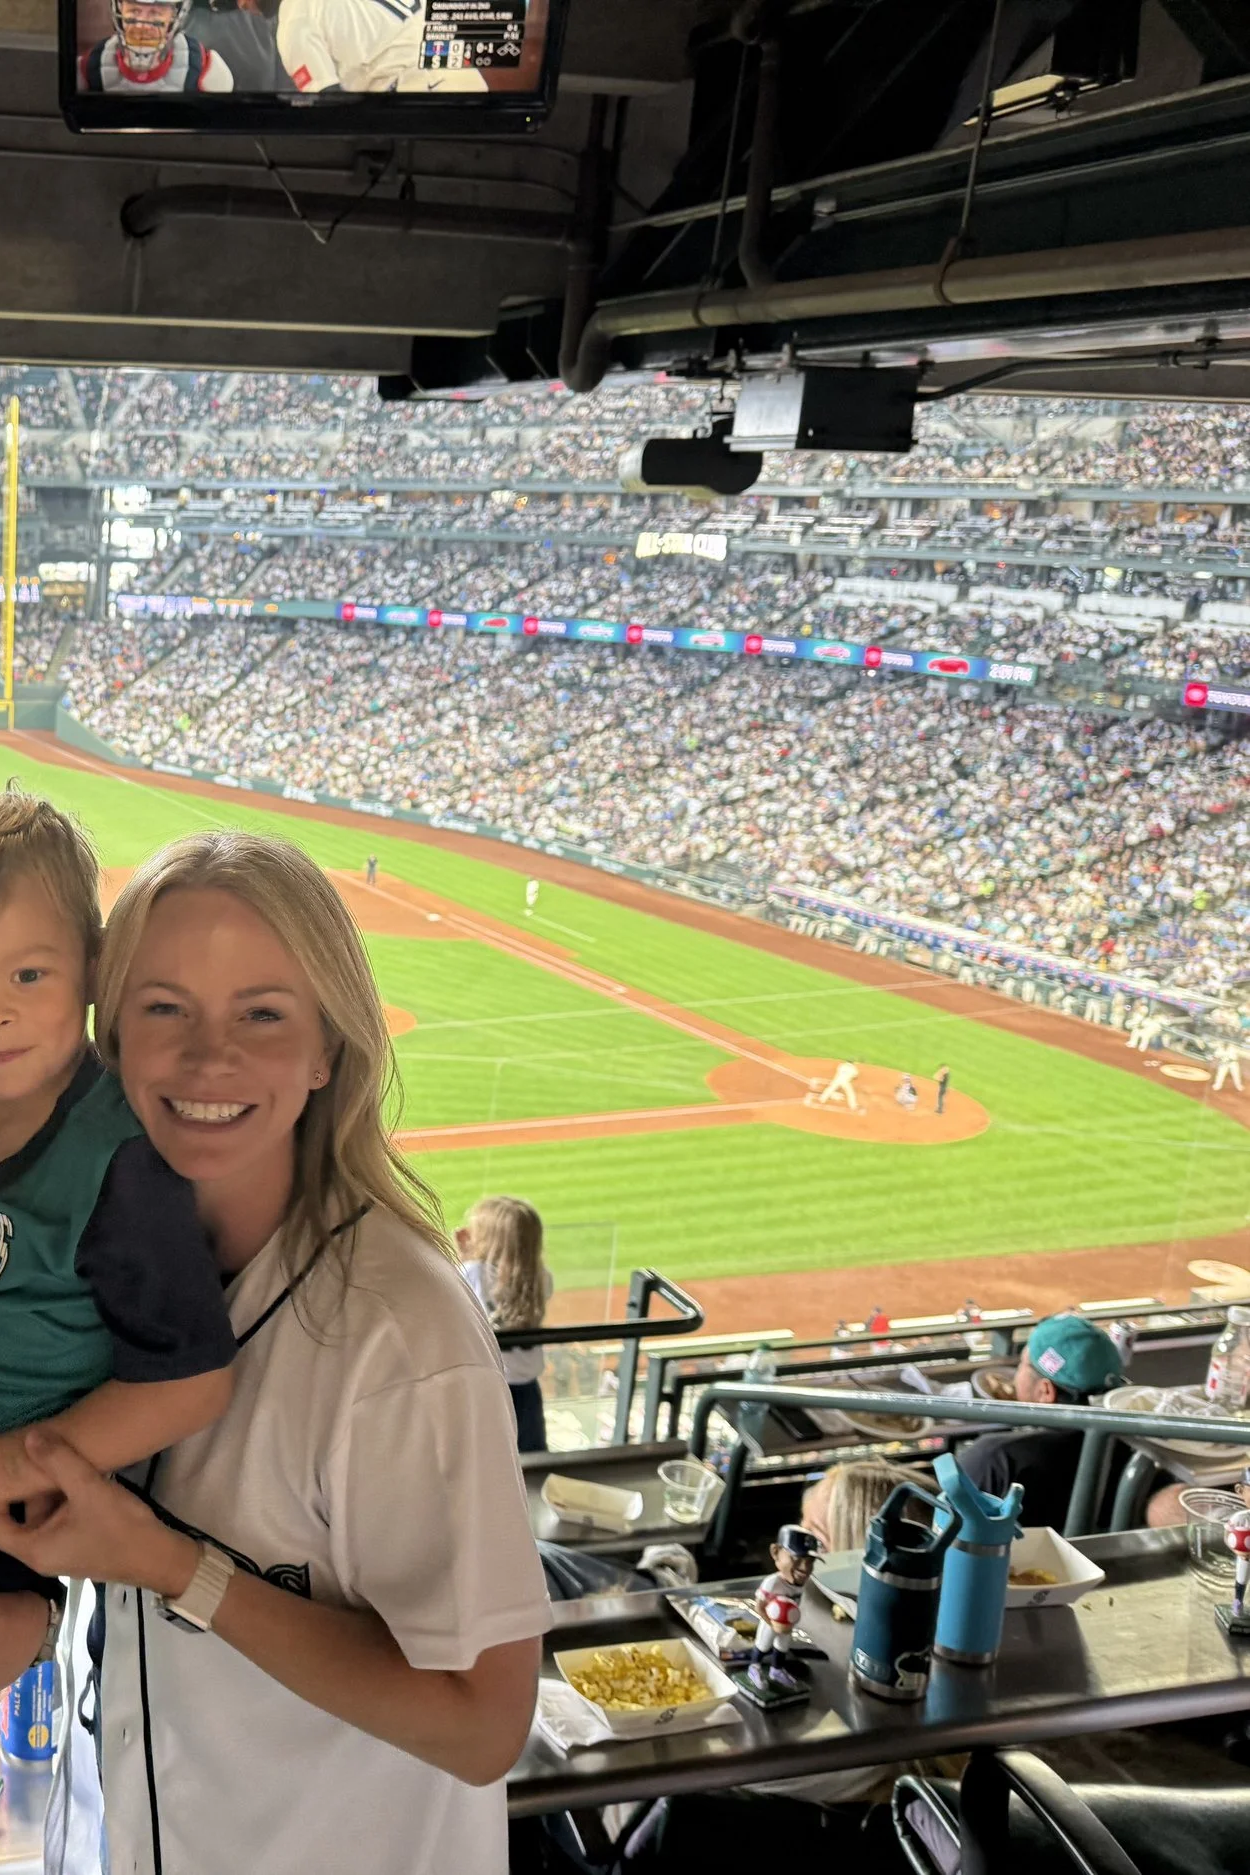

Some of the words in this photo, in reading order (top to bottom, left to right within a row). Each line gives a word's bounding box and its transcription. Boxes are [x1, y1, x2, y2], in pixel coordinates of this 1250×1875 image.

[452, 44, 460, 54] 0
[451, 57, 459, 68] 2
[1014, 666, 1033, 682] PM
[13, 1692, 21, 1717] PALE
